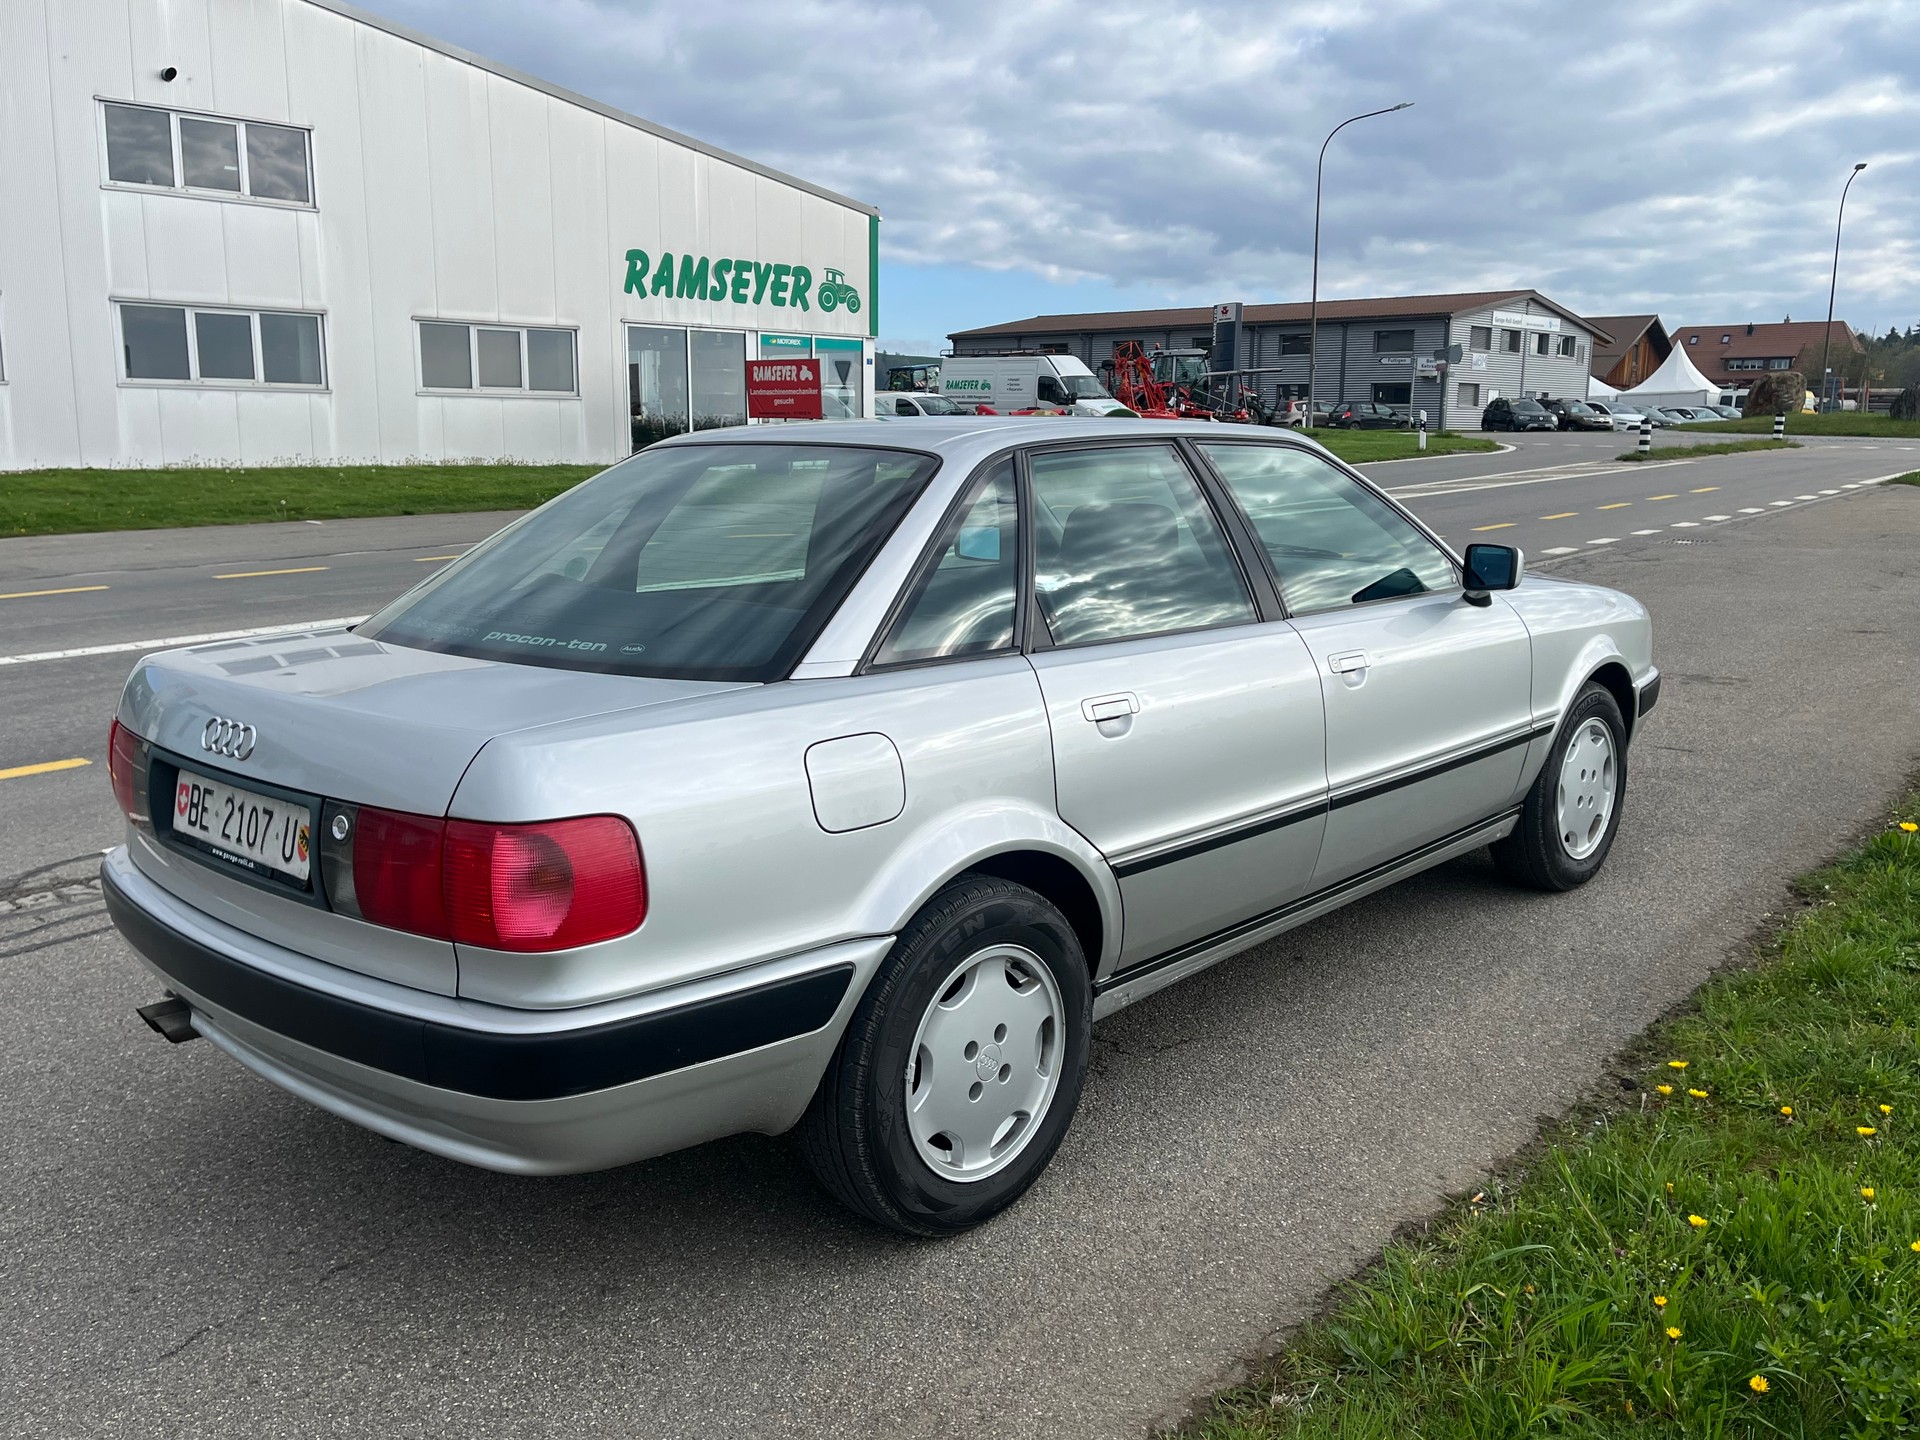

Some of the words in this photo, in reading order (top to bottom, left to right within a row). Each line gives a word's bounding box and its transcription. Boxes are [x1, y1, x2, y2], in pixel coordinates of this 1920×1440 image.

[624, 249, 812, 312] RAMSEYER
[753, 365, 797, 382] RAMSEYER
[749, 388, 818, 396] Landmaschinenmechaniker
[945, 380, 979, 390] RAMSEYER
[773, 398, 794, 406] gesucht
[482, 631, 607, 652] procon-ten
[188, 784, 214, 833] BE
[221, 796, 274, 855] 2107
[282, 816, 298, 863] U
[887, 912, 985, 1048] NEXEN
